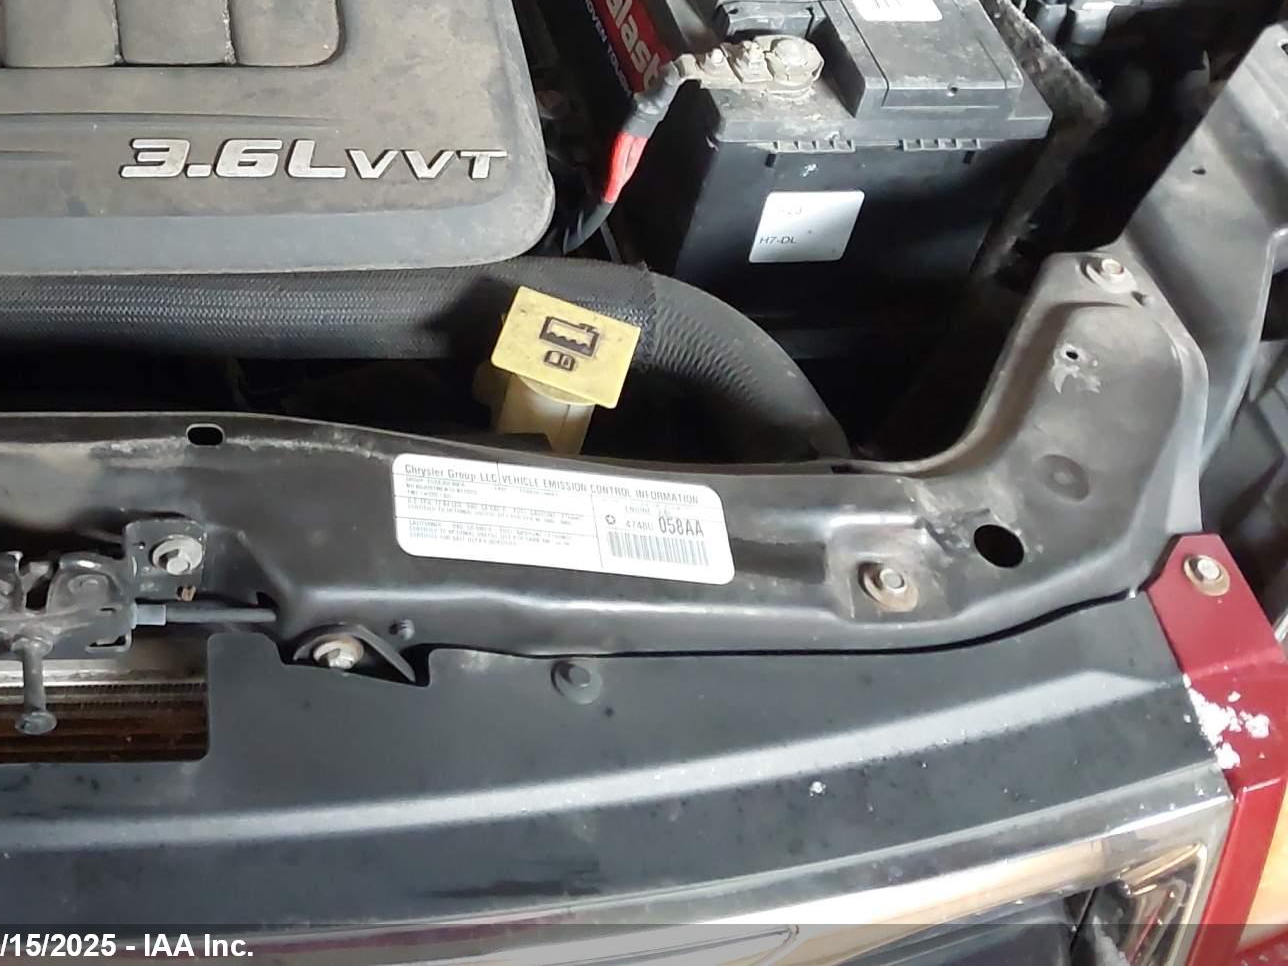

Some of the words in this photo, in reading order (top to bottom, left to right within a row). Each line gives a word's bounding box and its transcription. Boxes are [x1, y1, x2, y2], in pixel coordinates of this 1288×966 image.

[759, 235, 797, 244] H7-DL
[405, 464, 444, 478] Chrysler
[447, 469, 476, 482] Group
[479, 473, 498, 483] LLC
[501, 474, 539, 487] VEHICLE
[543, 479, 587, 492] EMISSION
[590, 484, 632, 498] CONTROL
[635, 489, 699, 504] INFORMATION
[658, 515, 705, 537] 058AA
